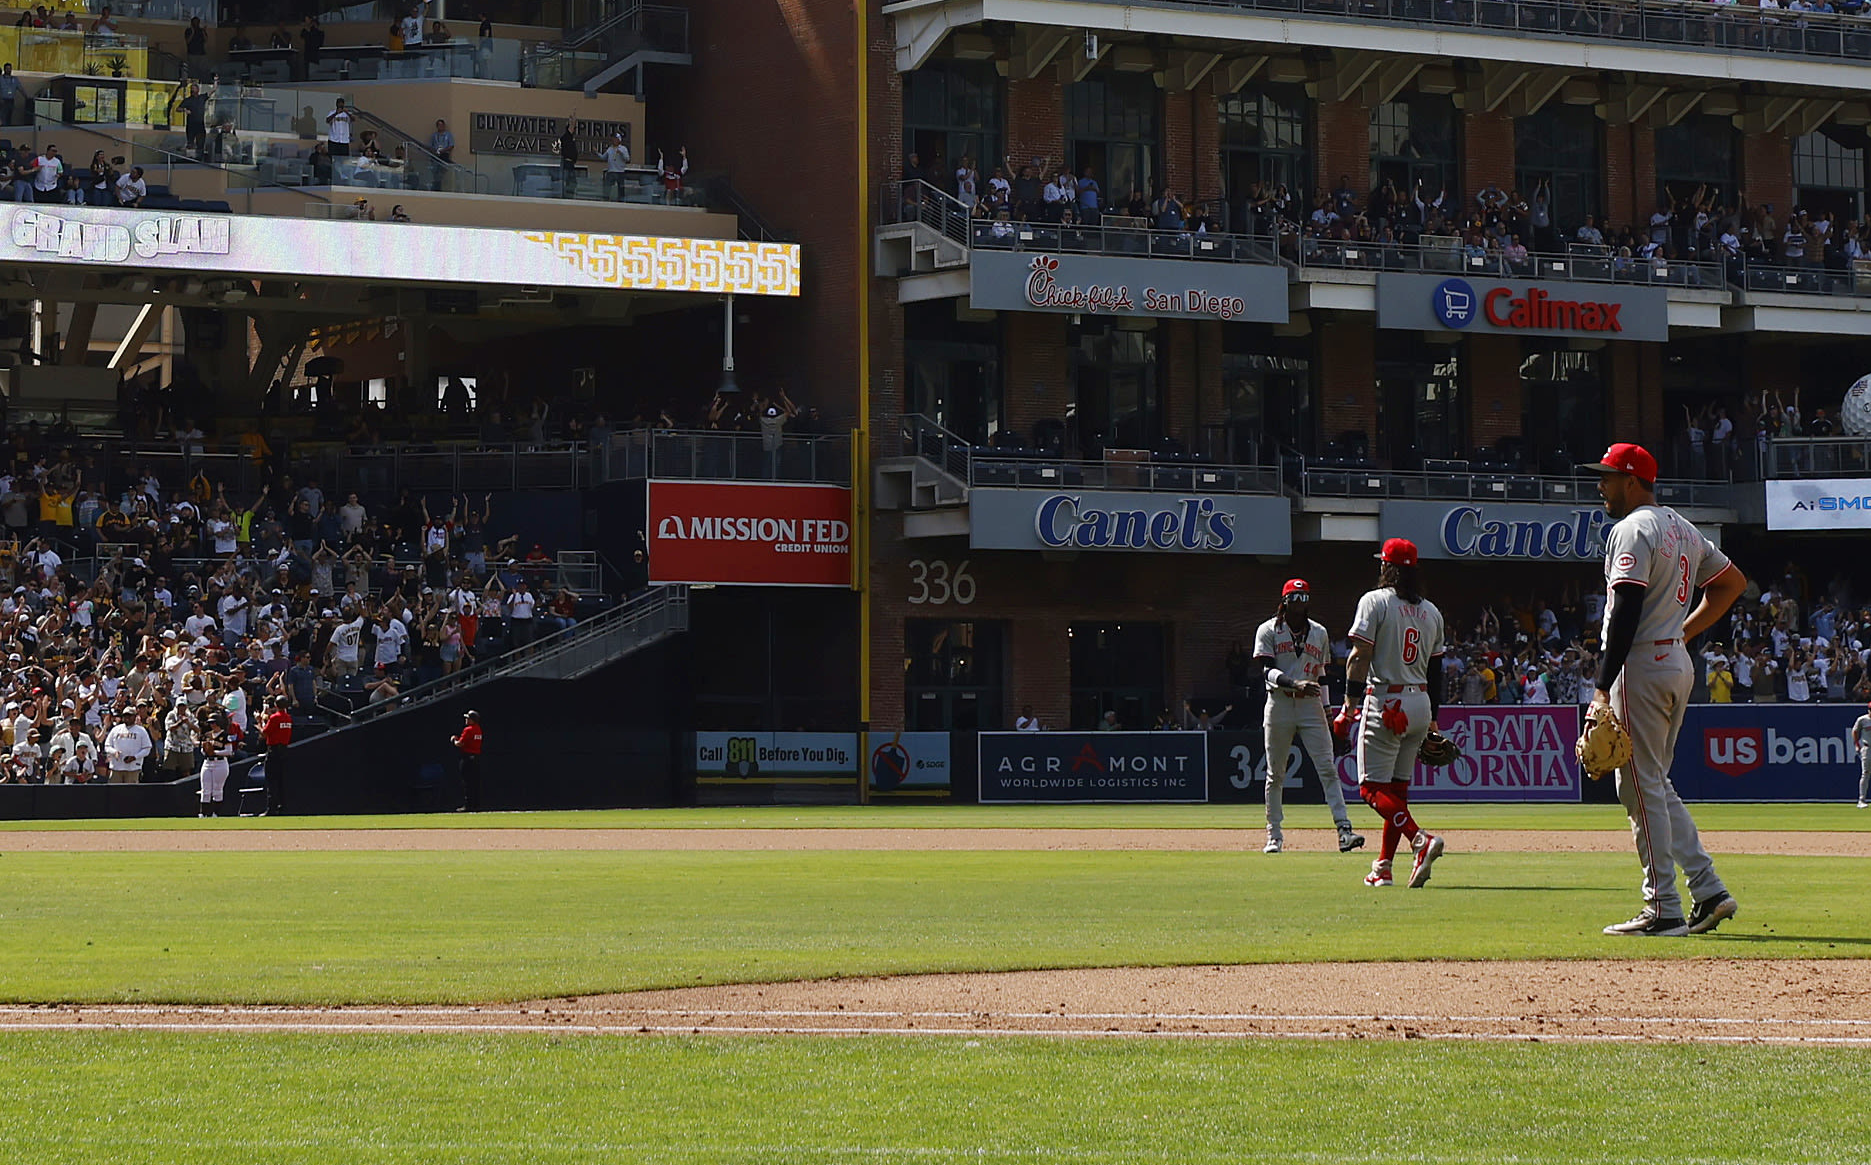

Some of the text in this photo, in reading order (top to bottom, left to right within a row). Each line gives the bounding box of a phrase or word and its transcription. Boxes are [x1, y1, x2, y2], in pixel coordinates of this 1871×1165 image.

[476, 114, 627, 136] CUTWATER PIRITS
[493, 135, 547, 152] AGAVE
[11, 207, 231, 262] GRAND SLAM
[1025, 267, 1246, 321] Chick-fil-A San Diego
[1484, 286, 1622, 332] Calimax
[689, 516, 850, 543] MISSION FED
[1034, 493, 1236, 555] Canel's
[774, 543, 849, 554] CREDIT UNION
[907, 559, 977, 605] 336
[1676, 552, 1690, 608] 3
[1402, 627, 1420, 666] 6
[699, 737, 849, 765] Call 811 Before You Dig.
[1472, 714, 1560, 753] BAJA
[1709, 736, 1758, 765] us
[998, 742, 1189, 773] AGRAMONT
[1000, 777, 1187, 789] WORLDWIDE LOGISTICS INC
